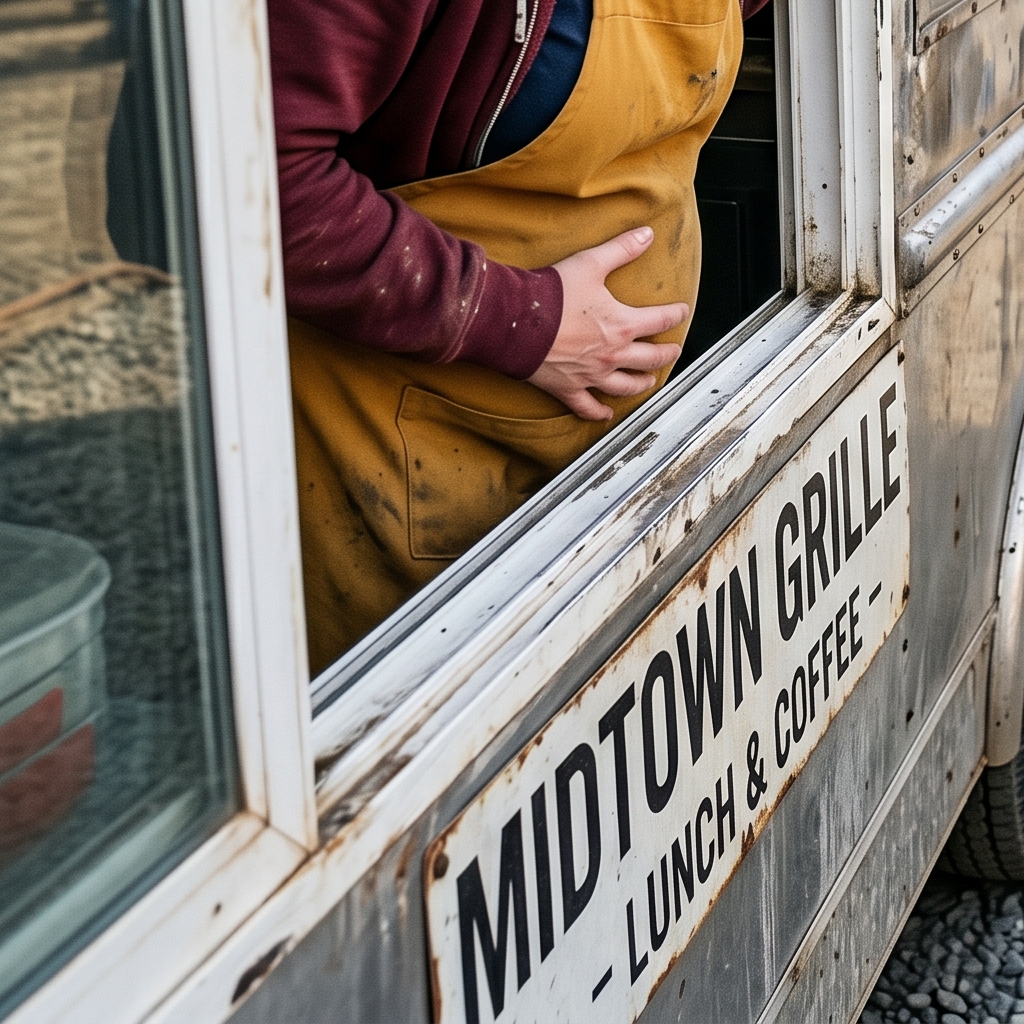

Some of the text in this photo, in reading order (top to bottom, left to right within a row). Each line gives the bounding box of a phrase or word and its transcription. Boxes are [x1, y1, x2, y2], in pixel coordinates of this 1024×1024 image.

[456, 383, 901, 1024] MIDTOWN GRILLE
[626, 765, 737, 987] LUNCH
[745, 730, 768, 811] &
[774, 580, 863, 770] COFFEE
